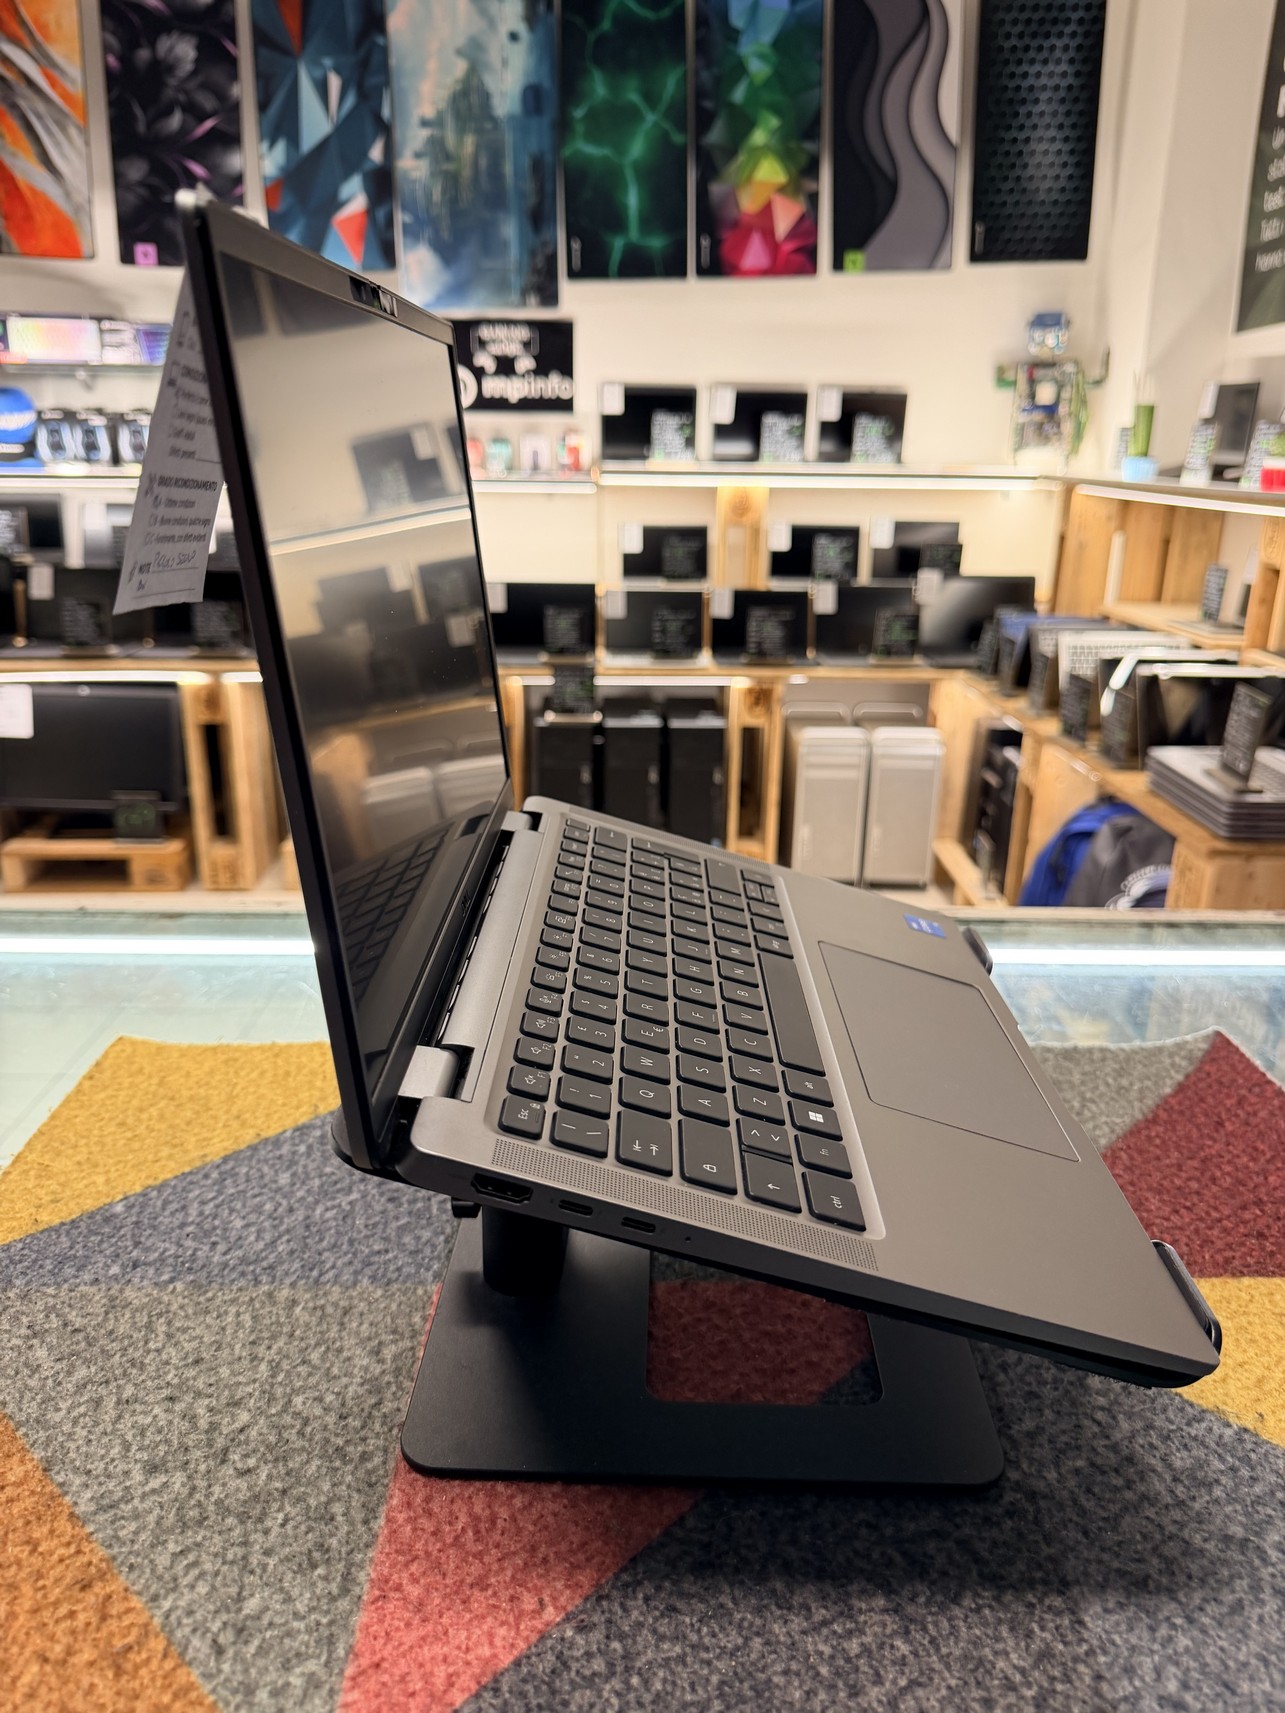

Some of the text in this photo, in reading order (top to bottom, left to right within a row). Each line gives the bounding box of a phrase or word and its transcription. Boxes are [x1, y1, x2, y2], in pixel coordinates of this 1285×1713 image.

[481, 370, 573, 403] mpinfo
[730, 947, 742, 955] M
[689, 964, 701, 973] H
[733, 967, 745, 976] N
[736, 989, 749, 997] B
[641, 1003, 654, 1011] R
[691, 1011, 705, 1019] F
[546, 1016, 556, 1025] F3
[594, 1030, 608, 1038] 3
[640, 1028, 655, 1038] E
[651, 1025, 665, 1034] €
[693, 1037, 707, 1046] D
[743, 1038, 757, 1046] C
[541, 1043, 552, 1051] F2
[591, 1059, 605, 1067] 2
[640, 1056, 654, 1067] W
[695, 1066, 710, 1074] S
[748, 1066, 762, 1075] X
[536, 1071, 547, 1079] F1
[639, 1089, 655, 1099] Q
[697, 1099, 712, 1107] A
[752, 1097, 767, 1106] Z
[517, 1107, 530, 1121] Esc
[829, 1195, 843, 1209] ctrl
